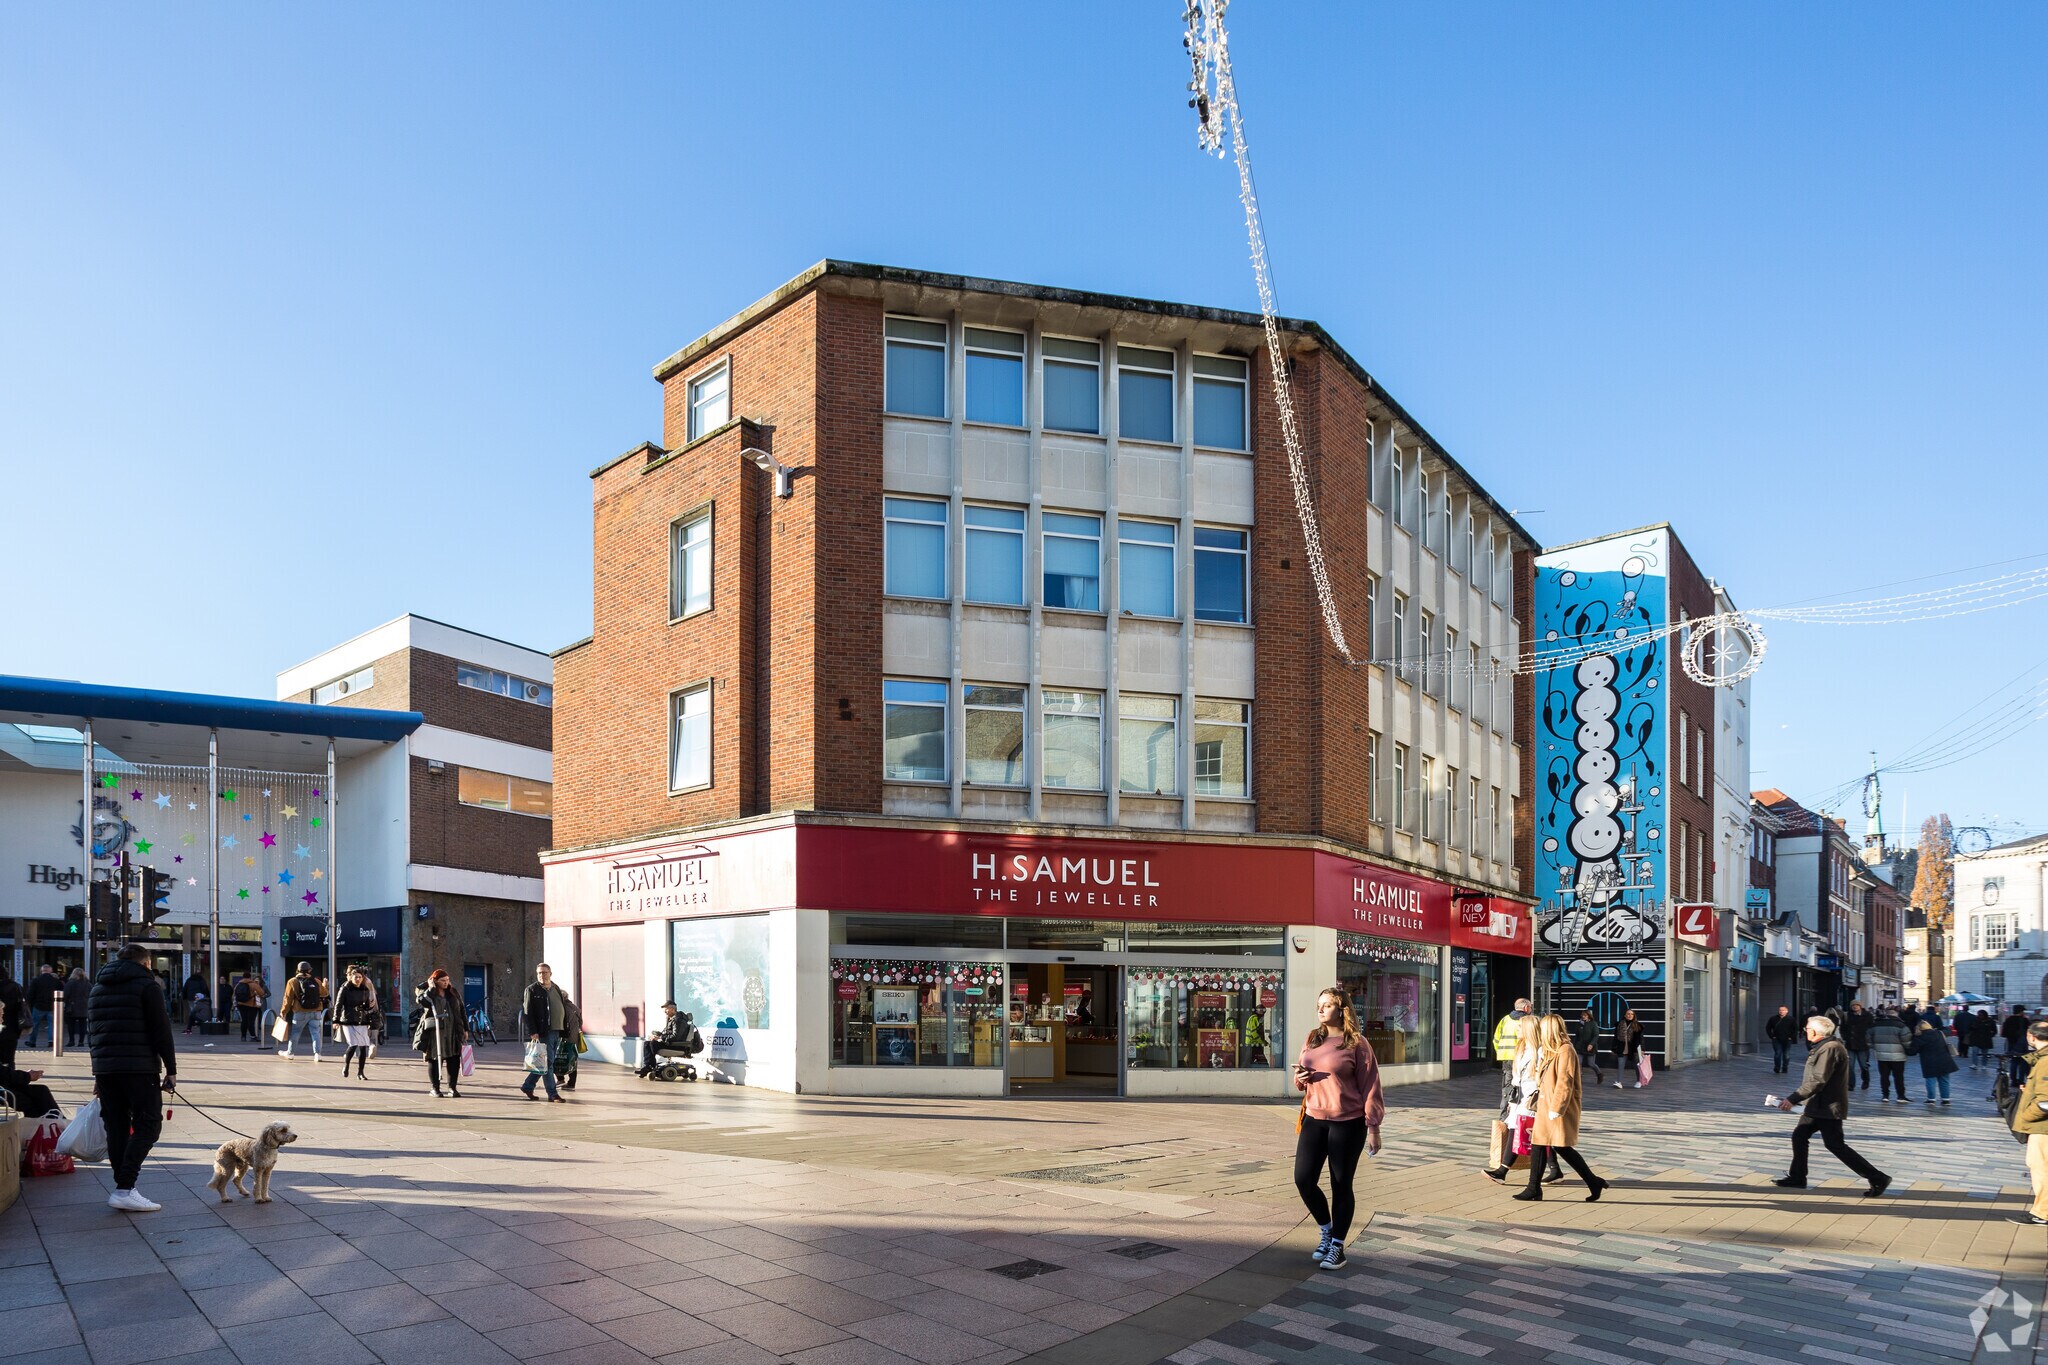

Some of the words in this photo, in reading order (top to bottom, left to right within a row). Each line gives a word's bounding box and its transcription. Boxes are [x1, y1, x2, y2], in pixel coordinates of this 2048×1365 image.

[28, 864, 83, 891] High
[608, 860, 708, 894] H.SAMUEL
[972, 852, 1160, 887] H.SAMUEL
[610, 899, 631, 911] THE
[639, 892, 707, 911] JEWELLER
[973, 888, 1018, 902] THE
[1036, 890, 1158, 907] JEWELLER
[1353, 878, 1424, 914] H.SAMUEL
[1353, 908, 1372, 922] THE
[1378, 913, 1423, 930] JEWELLER
[1462, 913, 1487, 923] NEY
[296, 932, 318, 943] Pharmacy
[359, 927, 377, 940] Beauty
[706, 1035, 735, 1046] SEIKO
